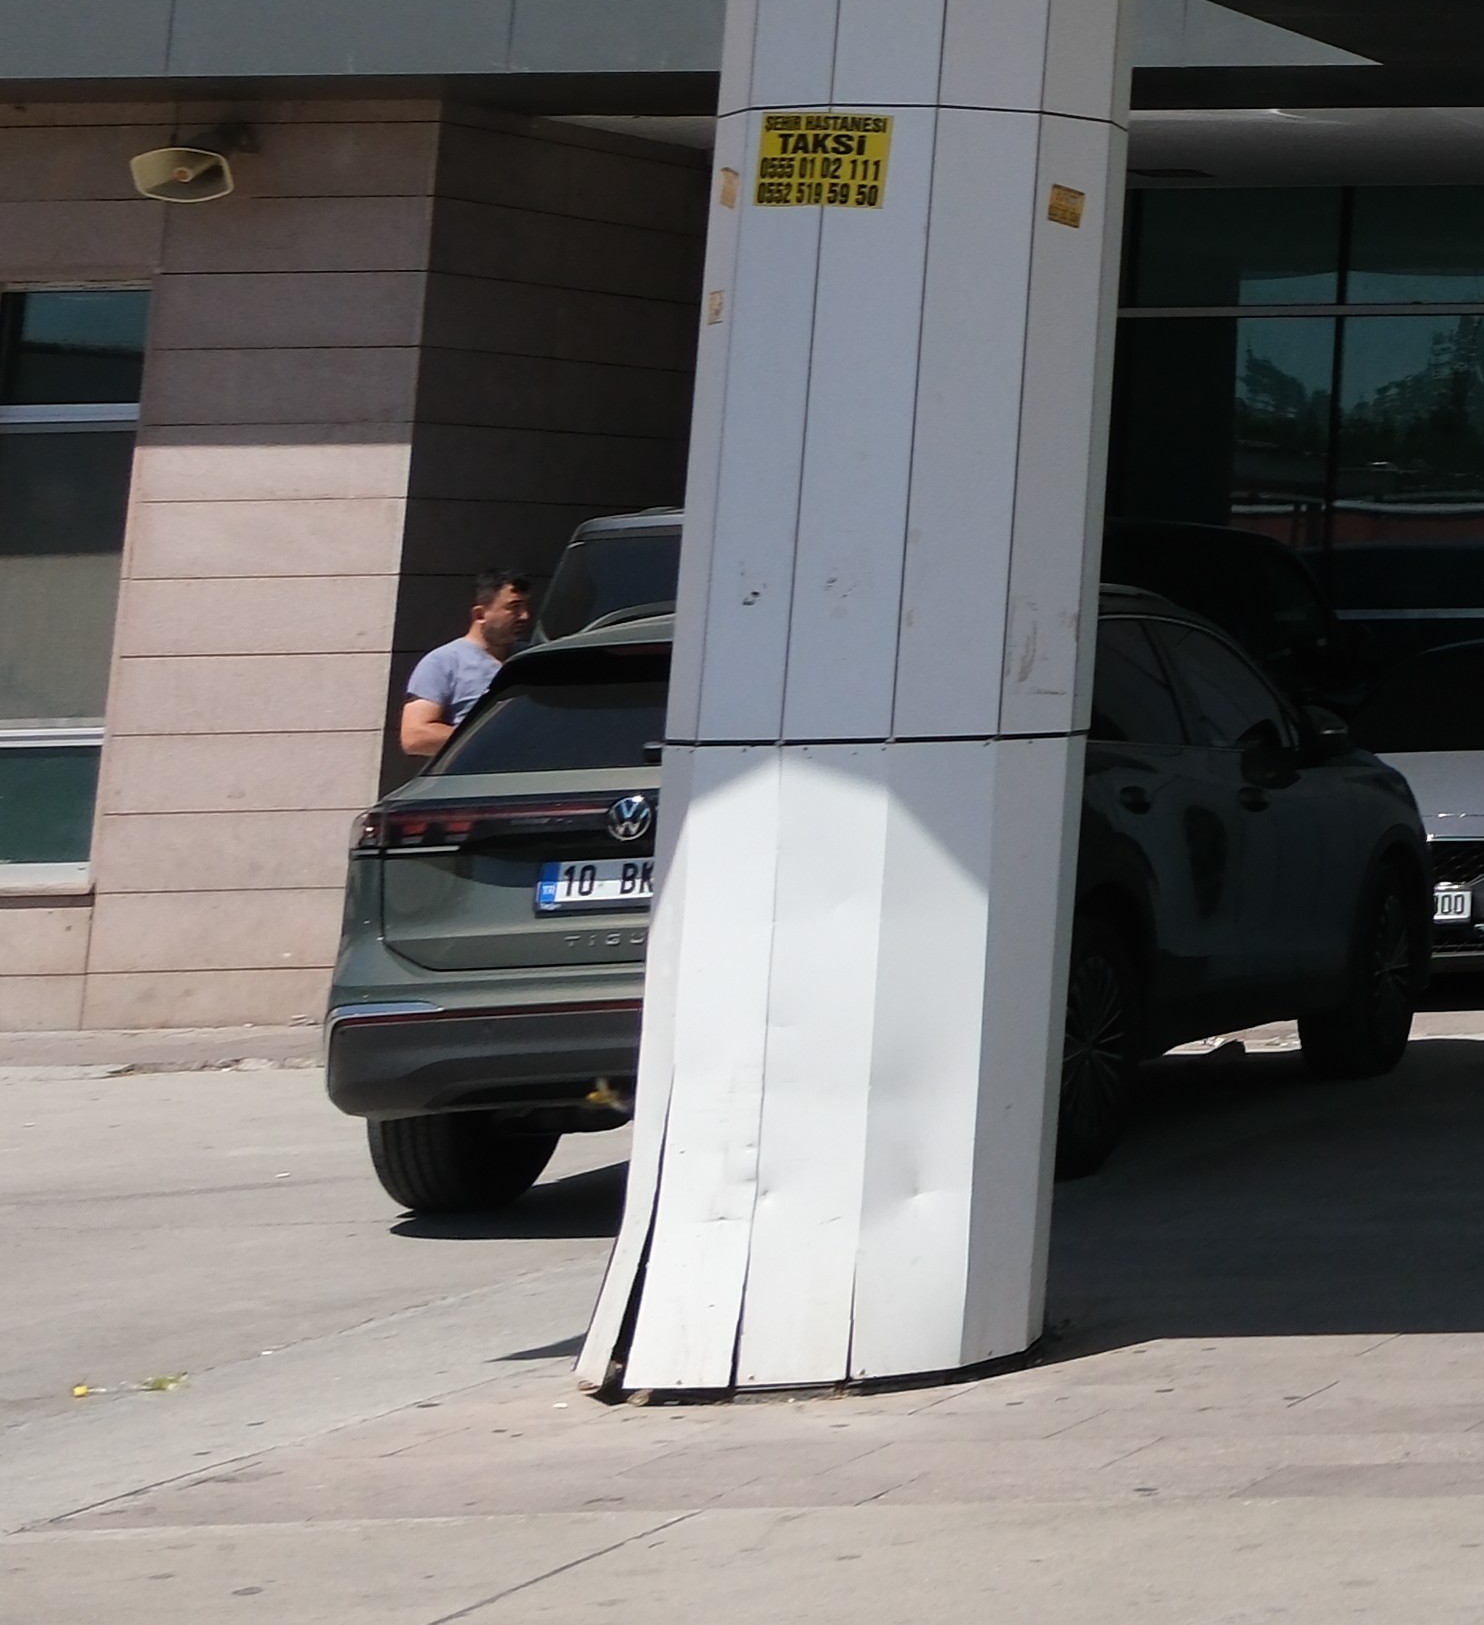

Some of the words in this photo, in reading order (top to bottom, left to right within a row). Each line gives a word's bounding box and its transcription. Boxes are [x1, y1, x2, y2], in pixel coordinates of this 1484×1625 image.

[778, 133, 867, 156] TAKSİ
[760, 157, 795, 179] 0555
[800, 158, 816, 179] 01
[821, 158, 843, 180] 02
[850, 159, 882, 181] 111
[757, 182, 793, 205] 0552
[796, 182, 823, 204] 519
[827, 183, 850, 205] 59
[856, 184, 879, 206] 50
[564, 864, 597, 897] 10
